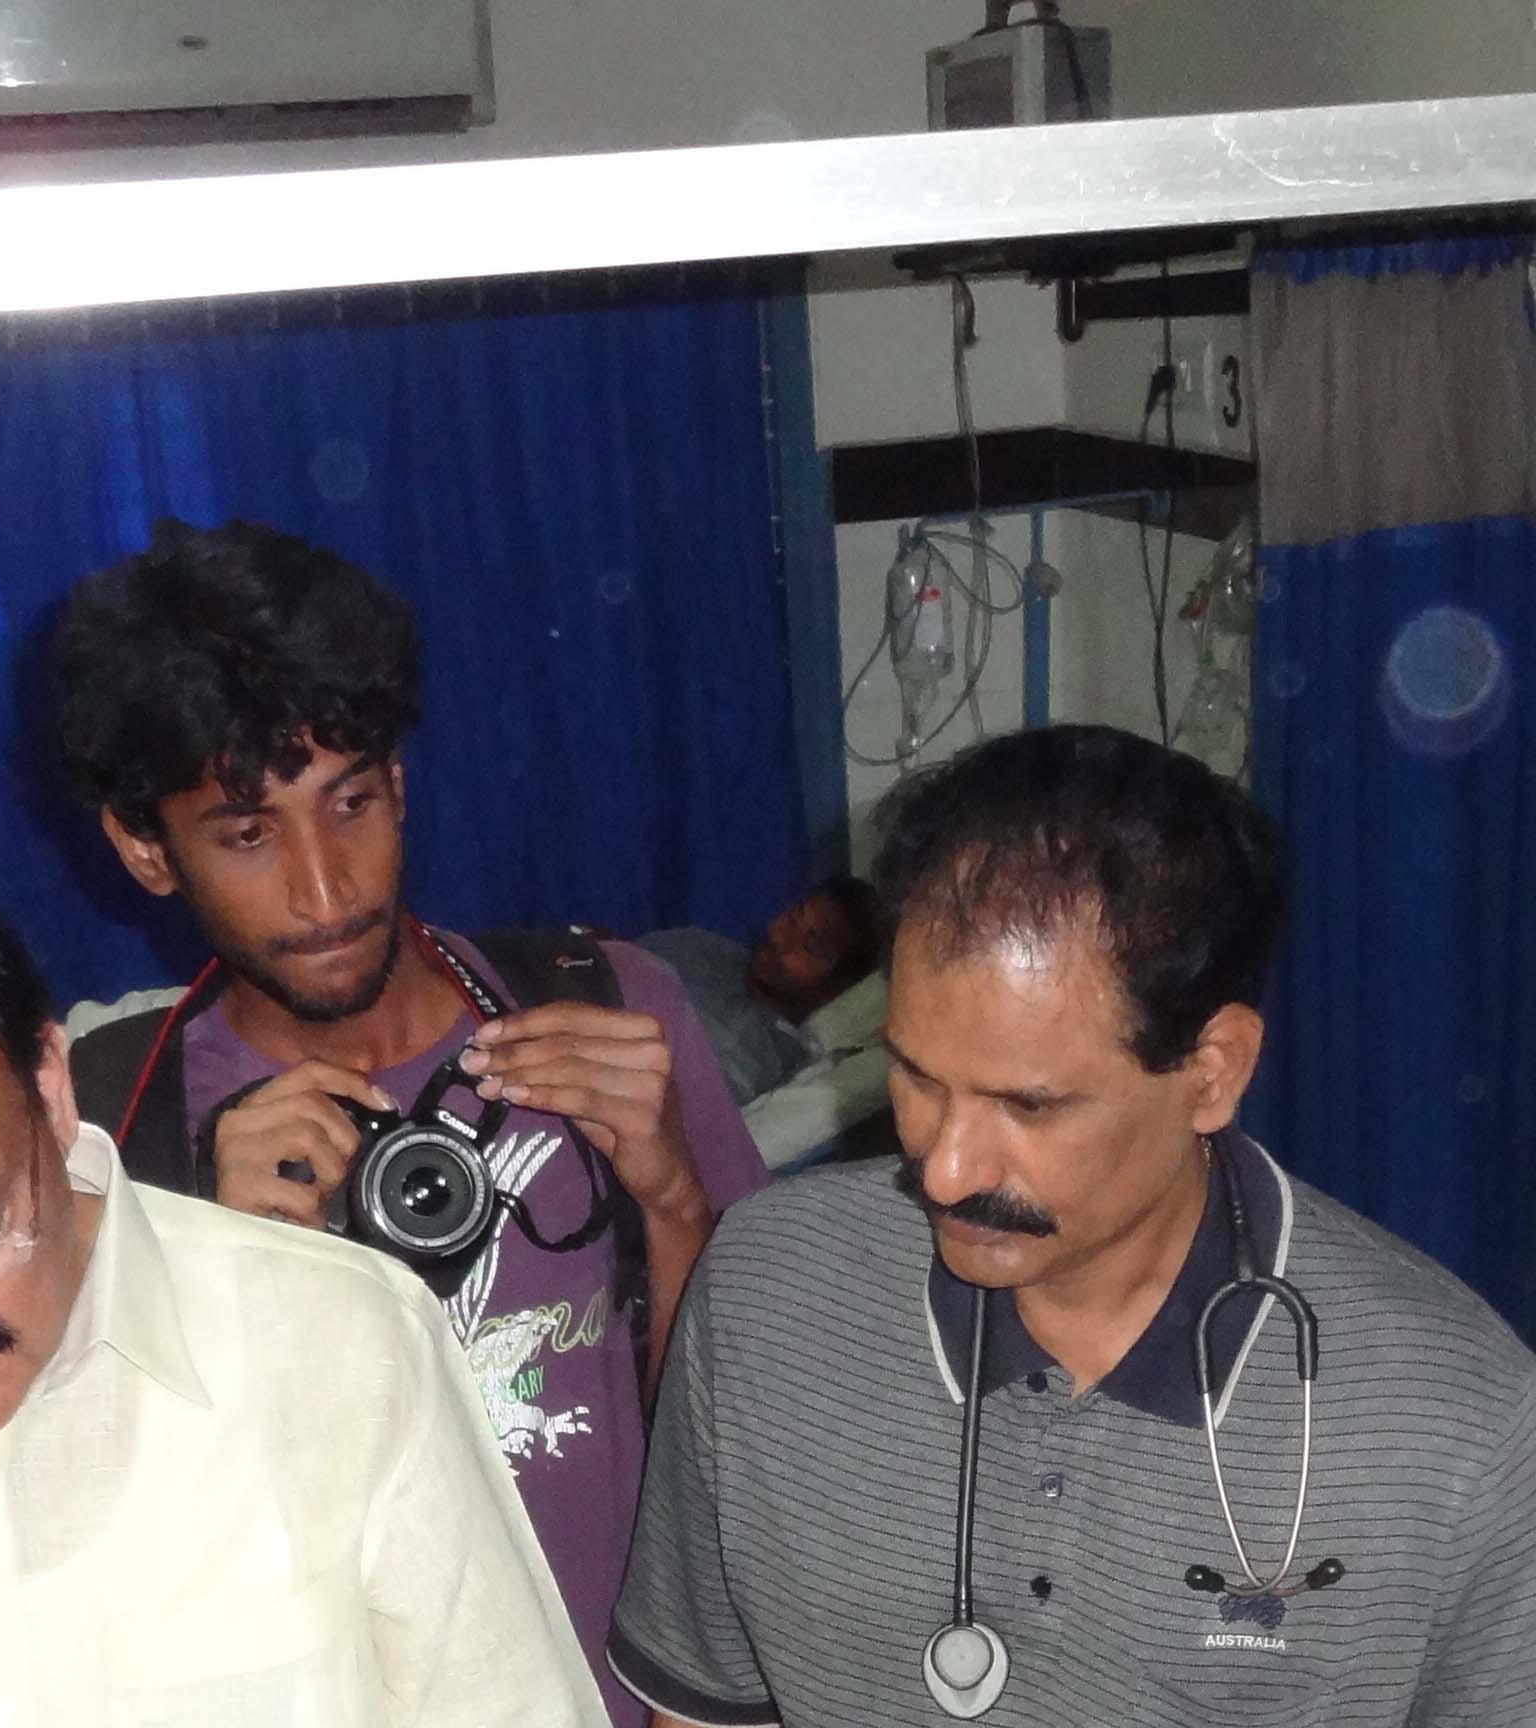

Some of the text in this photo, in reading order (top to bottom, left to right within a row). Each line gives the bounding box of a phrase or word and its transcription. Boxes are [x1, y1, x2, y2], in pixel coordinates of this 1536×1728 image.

[1221, 355, 1243, 428] 3
[438, 1110, 478, 1140] Canon
[1205, 1634, 1286, 1651] AUSTRALIA
